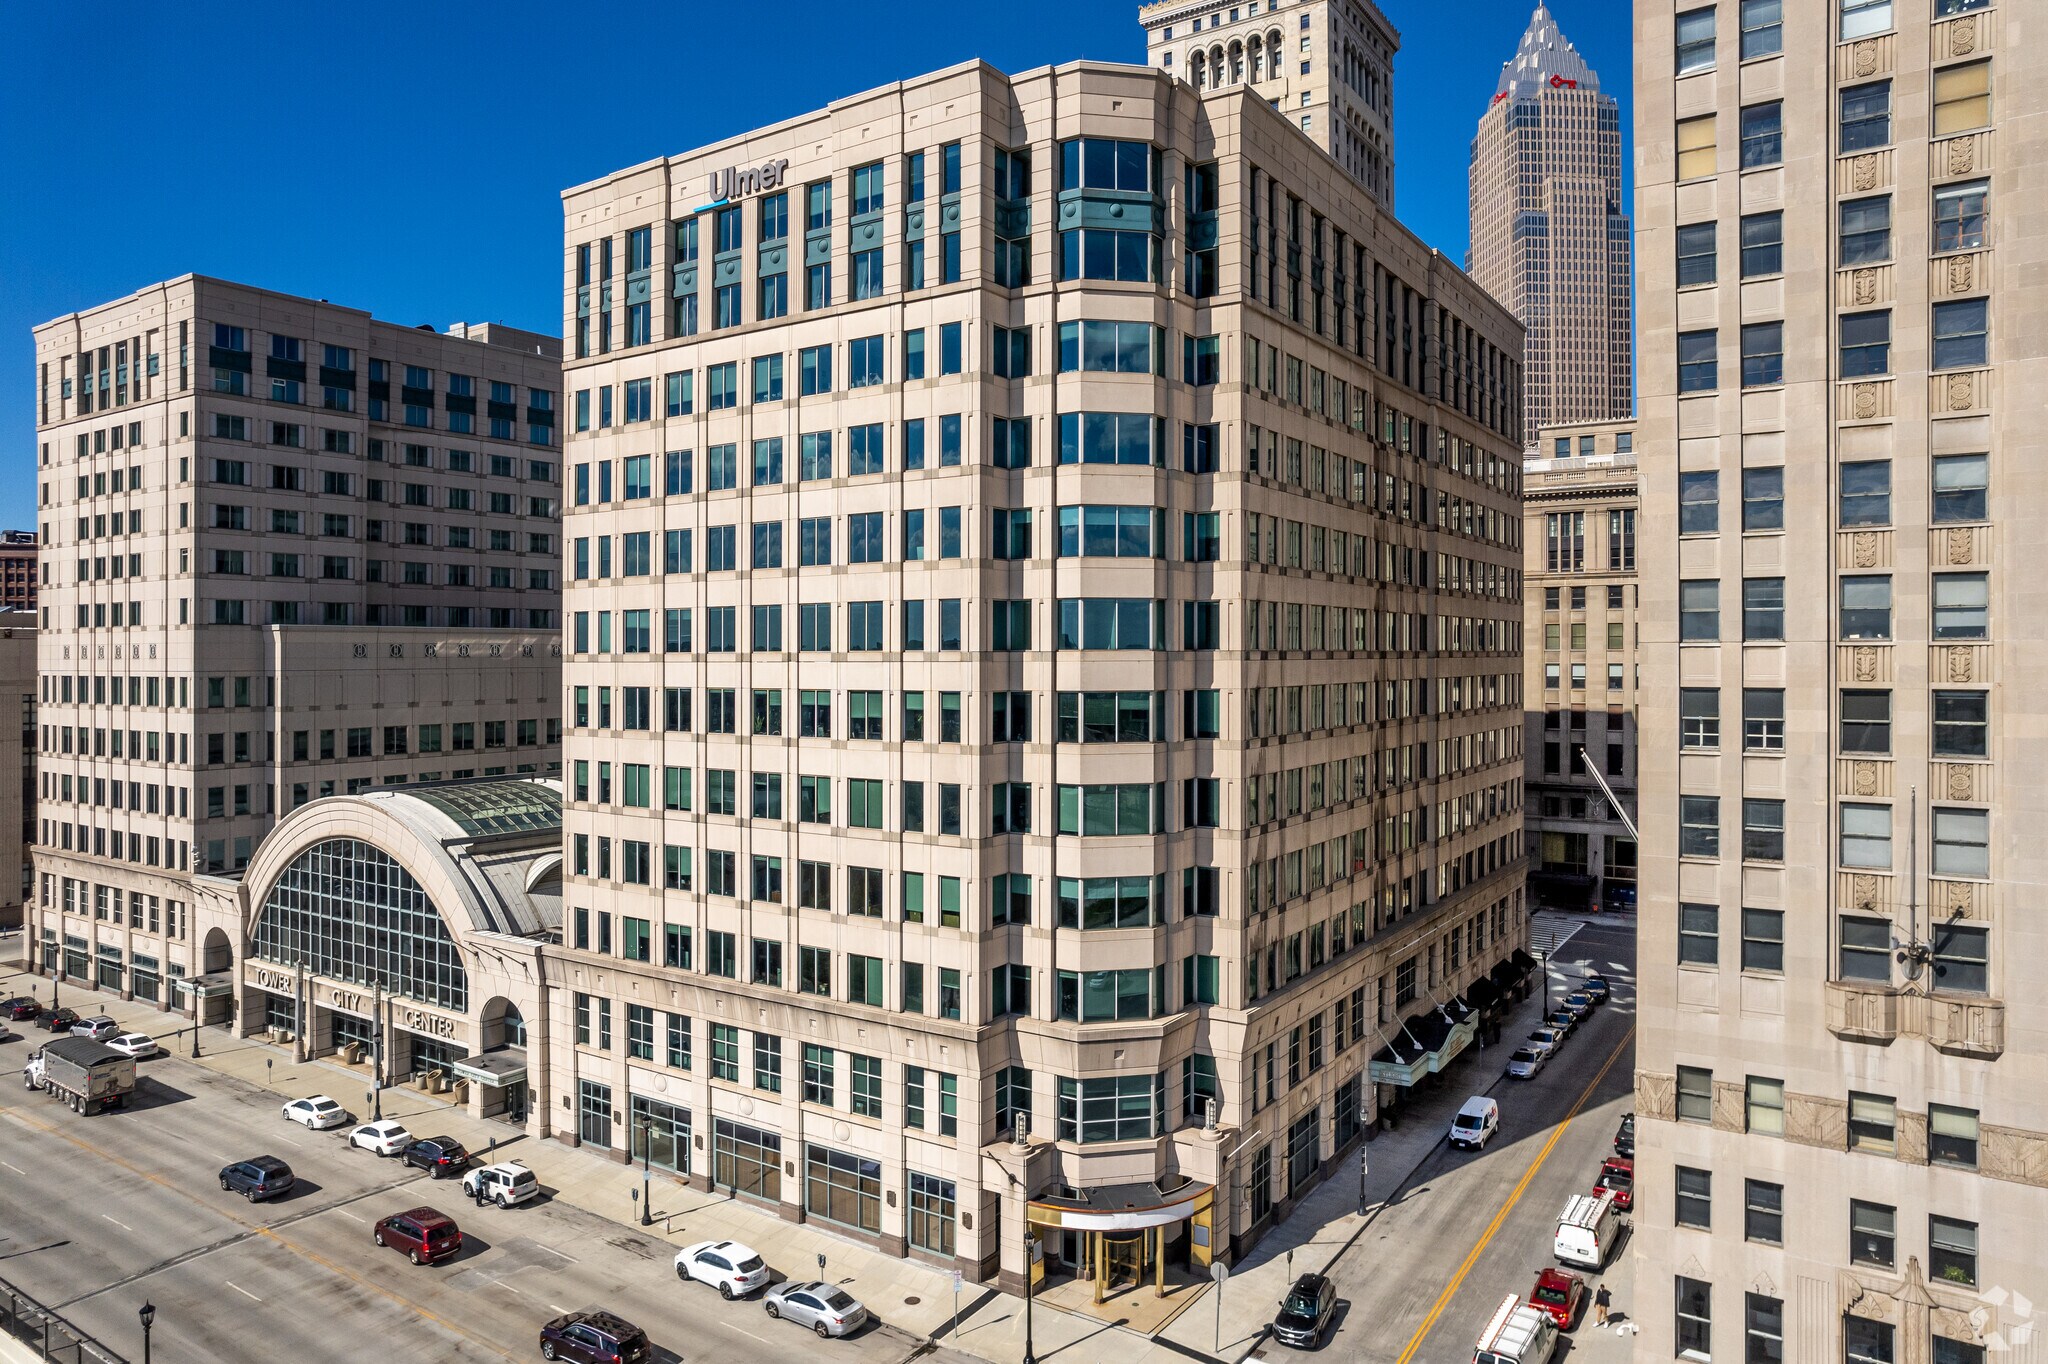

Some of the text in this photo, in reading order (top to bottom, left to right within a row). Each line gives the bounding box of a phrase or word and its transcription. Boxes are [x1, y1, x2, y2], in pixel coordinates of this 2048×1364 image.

[709, 158, 789, 202] Ulmer
[255, 968, 455, 1040] TOWER CITY CENTER
